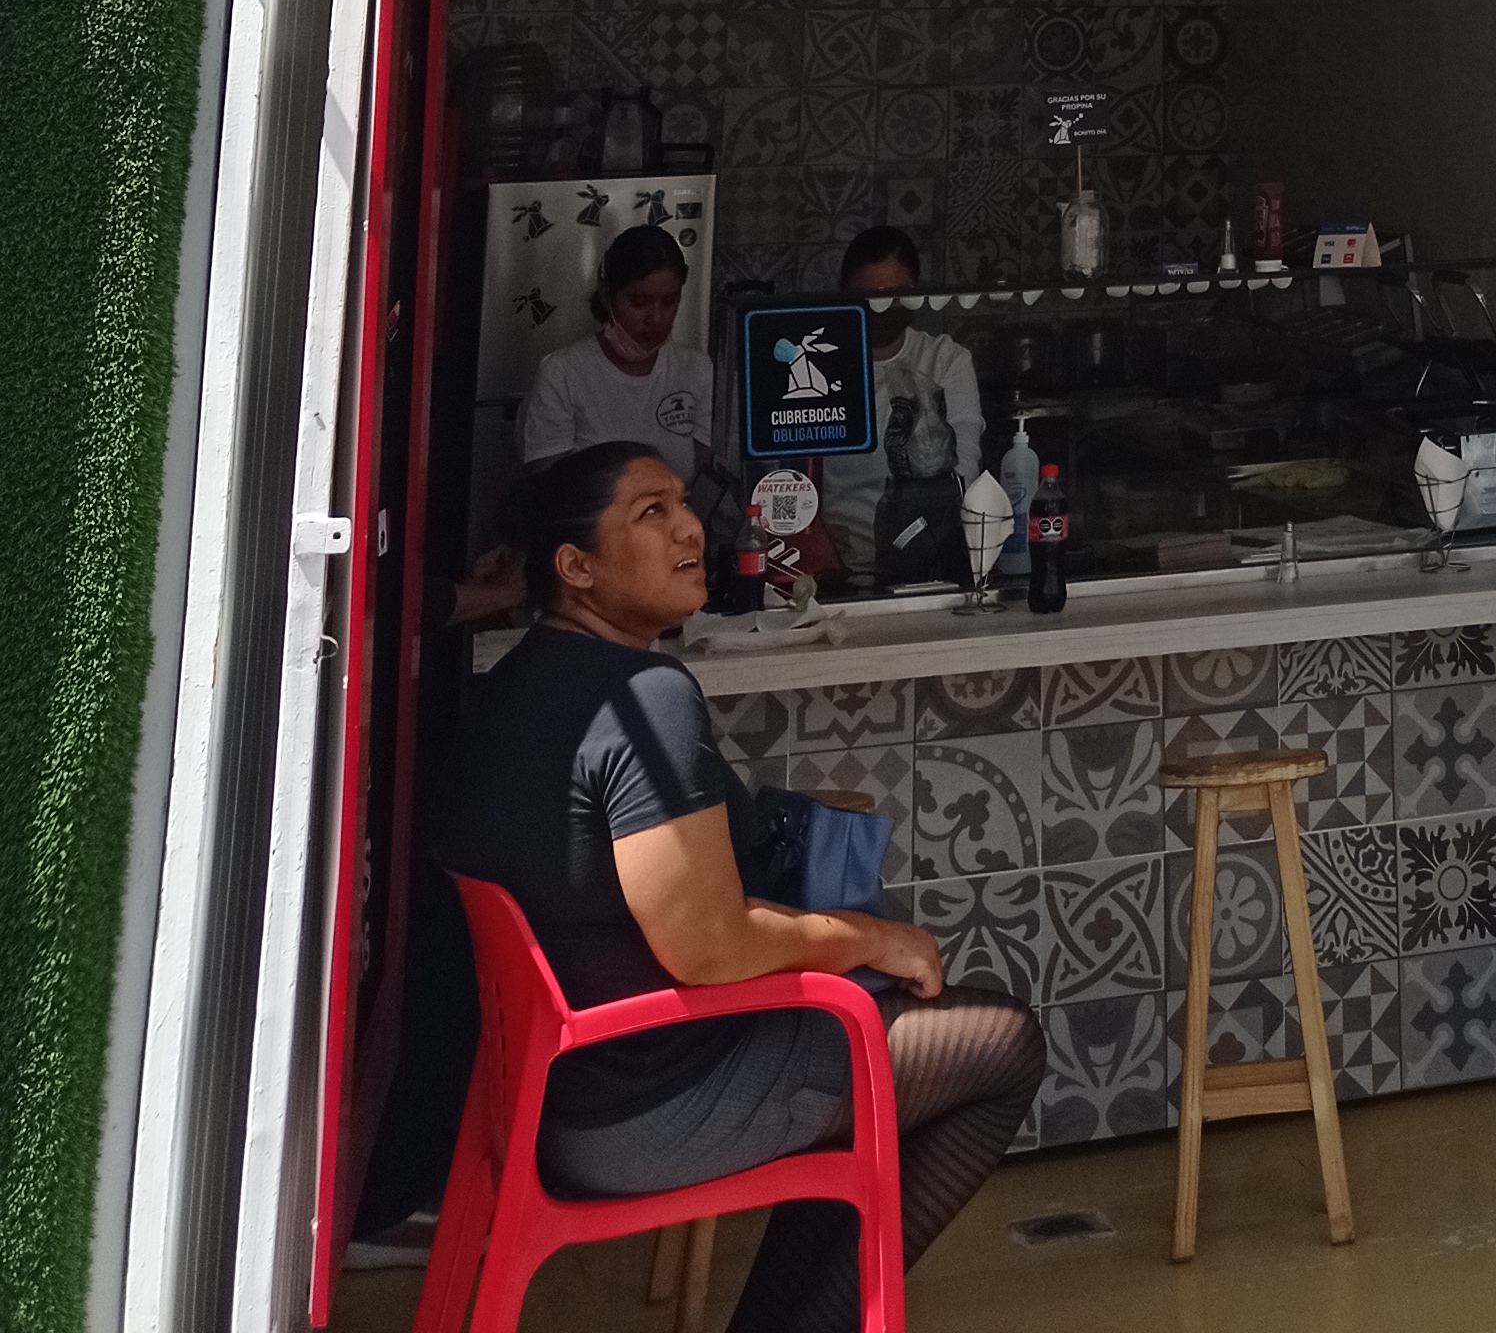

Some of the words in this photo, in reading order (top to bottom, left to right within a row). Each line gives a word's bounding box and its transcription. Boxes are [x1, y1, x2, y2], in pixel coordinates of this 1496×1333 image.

[1047, 95, 1079, 104] GRACIAS
[1061, 102, 1094, 111] PROPINA
[771, 406, 847, 426] CUBREBOCAS
[773, 424, 847, 443] OBLIGATORIO
[757, 483, 812, 493] WATEKERS
